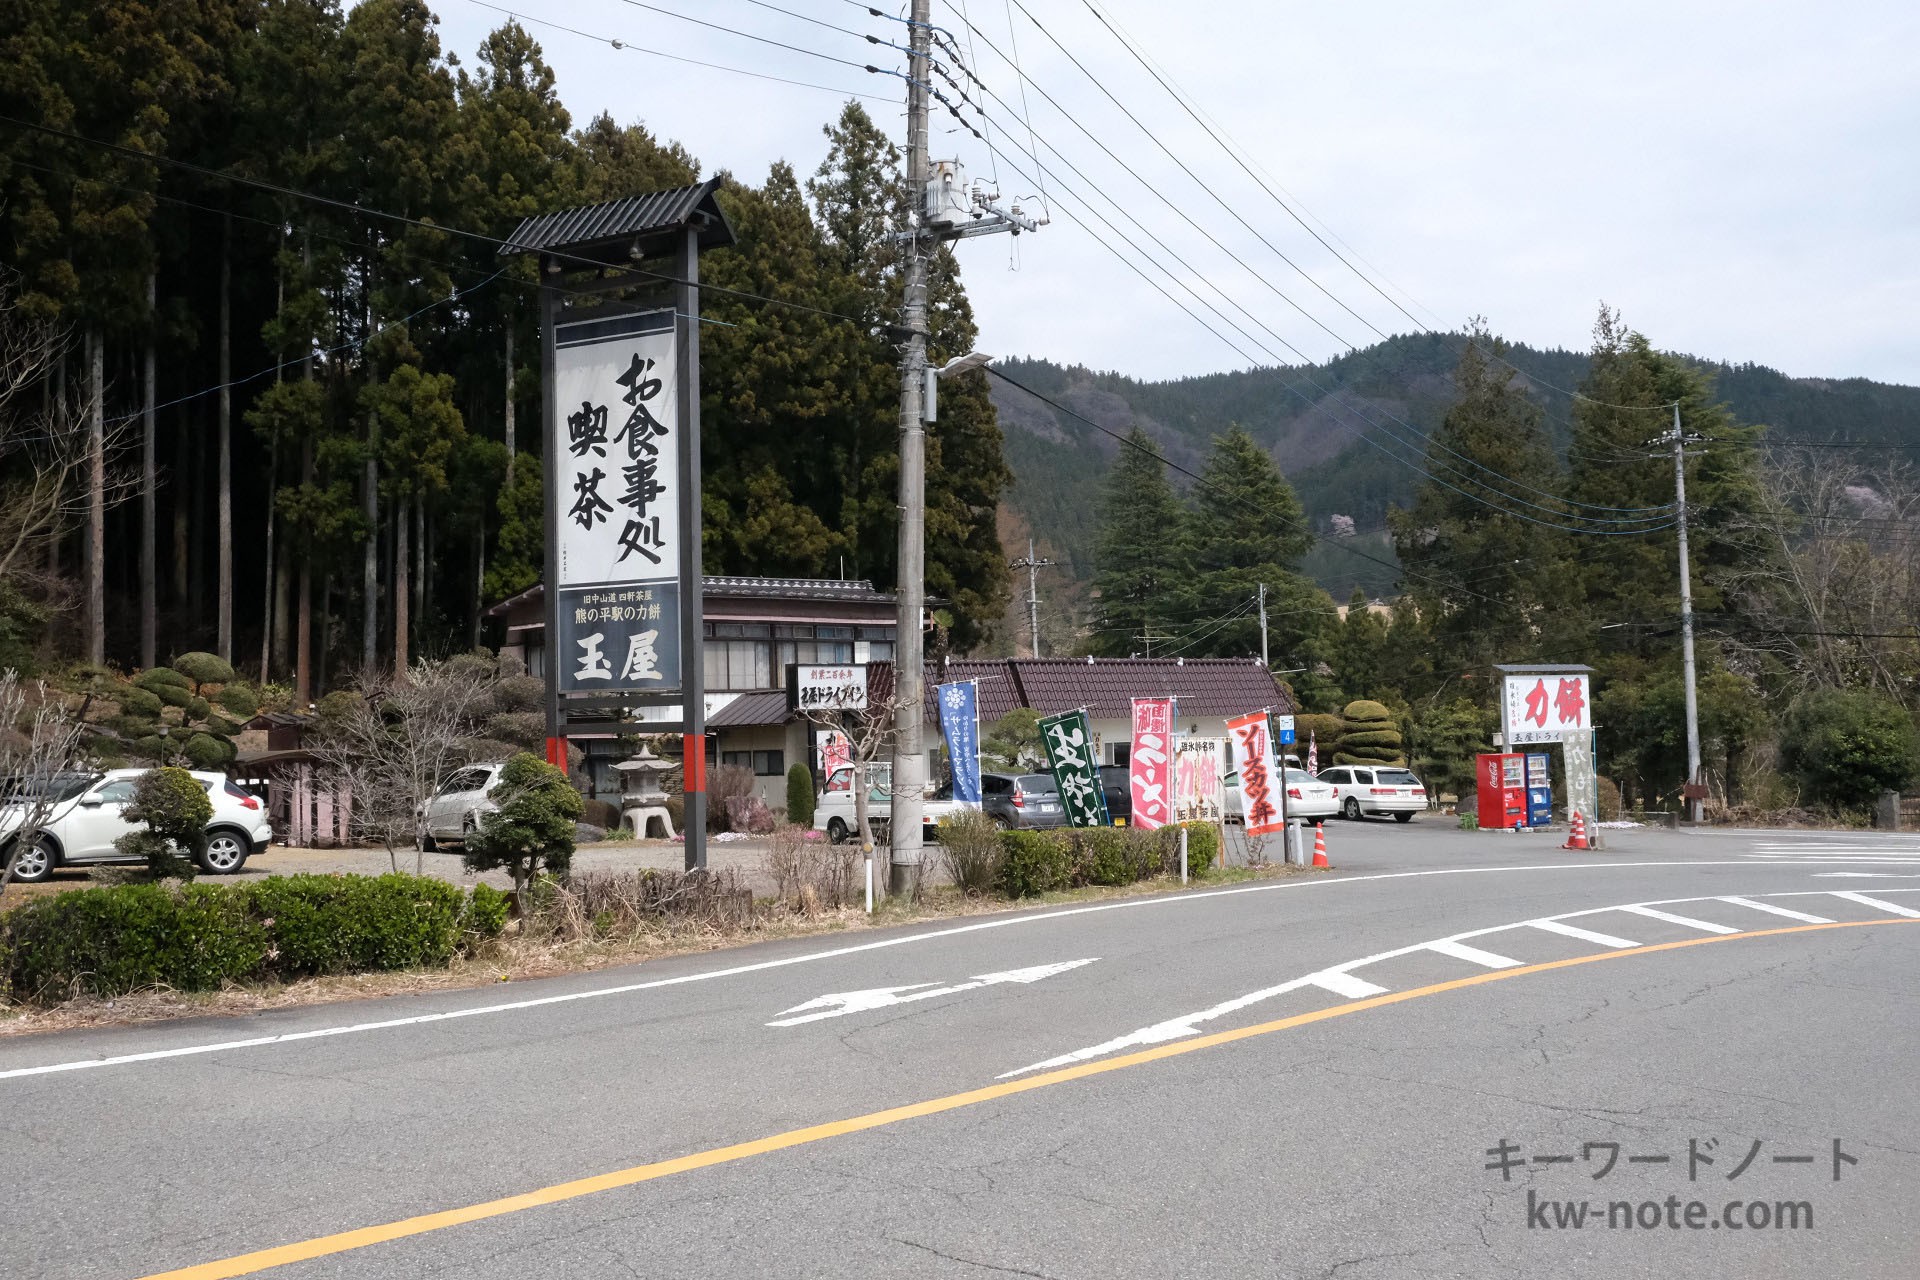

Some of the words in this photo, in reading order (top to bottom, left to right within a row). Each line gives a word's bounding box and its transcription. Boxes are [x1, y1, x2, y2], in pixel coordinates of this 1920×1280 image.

[567, 400, 614, 531] 喫茶
[613, 352, 669, 565] お食事処
[575, 602, 661, 625] 熊の平駅の力餅
[583, 593, 617, 604] 旧中山道
[619, 590, 653, 602] 四軒茶屋
[573, 629, 664, 682] 玉屋
[1524, 677, 1586, 728] 力餅
[1285, 731, 1291, 742] 4
[1177, 754, 1217, 796] 力餅
[1236, 723, 1277, 826] ソースカツ丼
